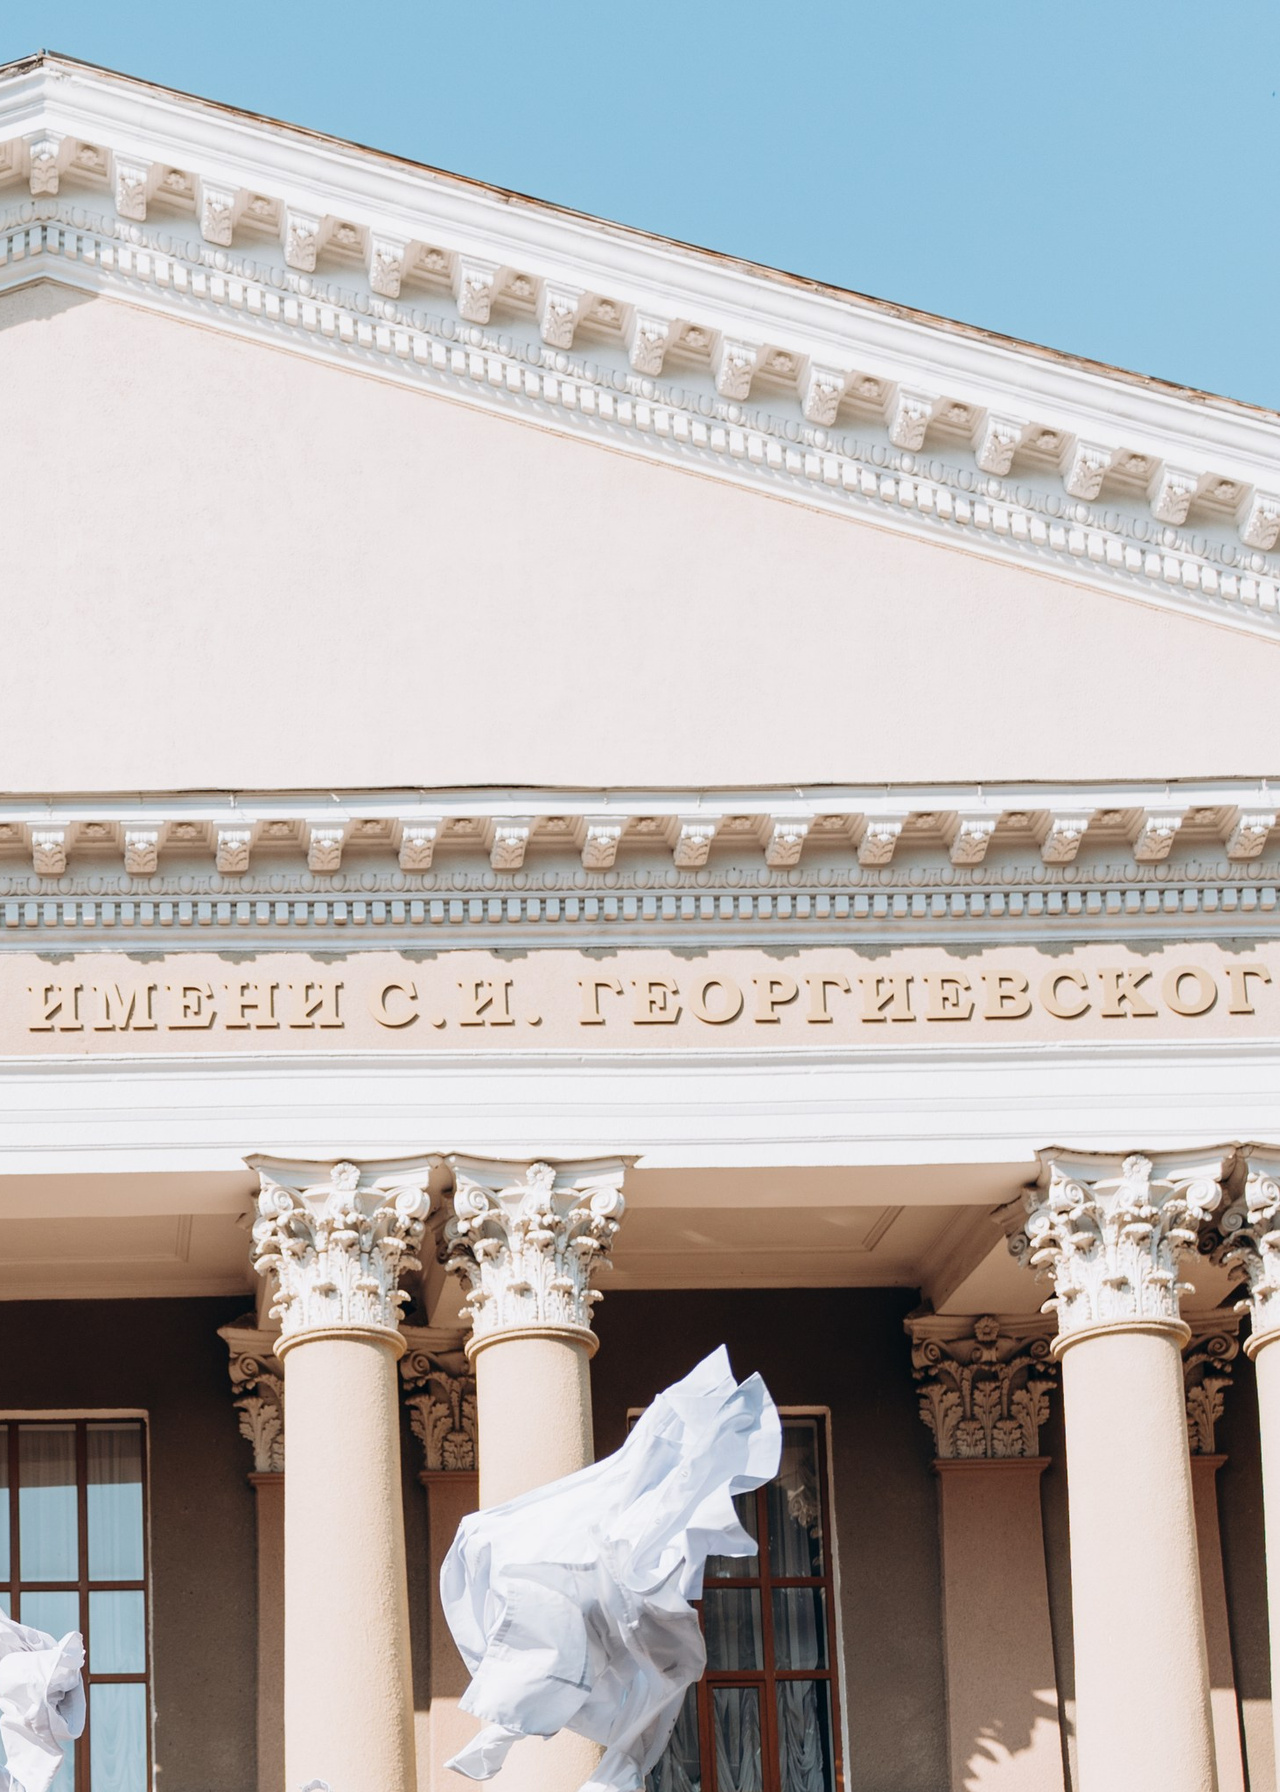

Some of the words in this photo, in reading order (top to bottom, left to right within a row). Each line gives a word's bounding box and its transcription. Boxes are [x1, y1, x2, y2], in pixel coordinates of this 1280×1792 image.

[26, 980, 347, 1034] ИМЕНИ
[366, 977, 544, 1029] С.И.
[577, 963, 1273, 1029] ГЕОРГИЕВСКОГ
